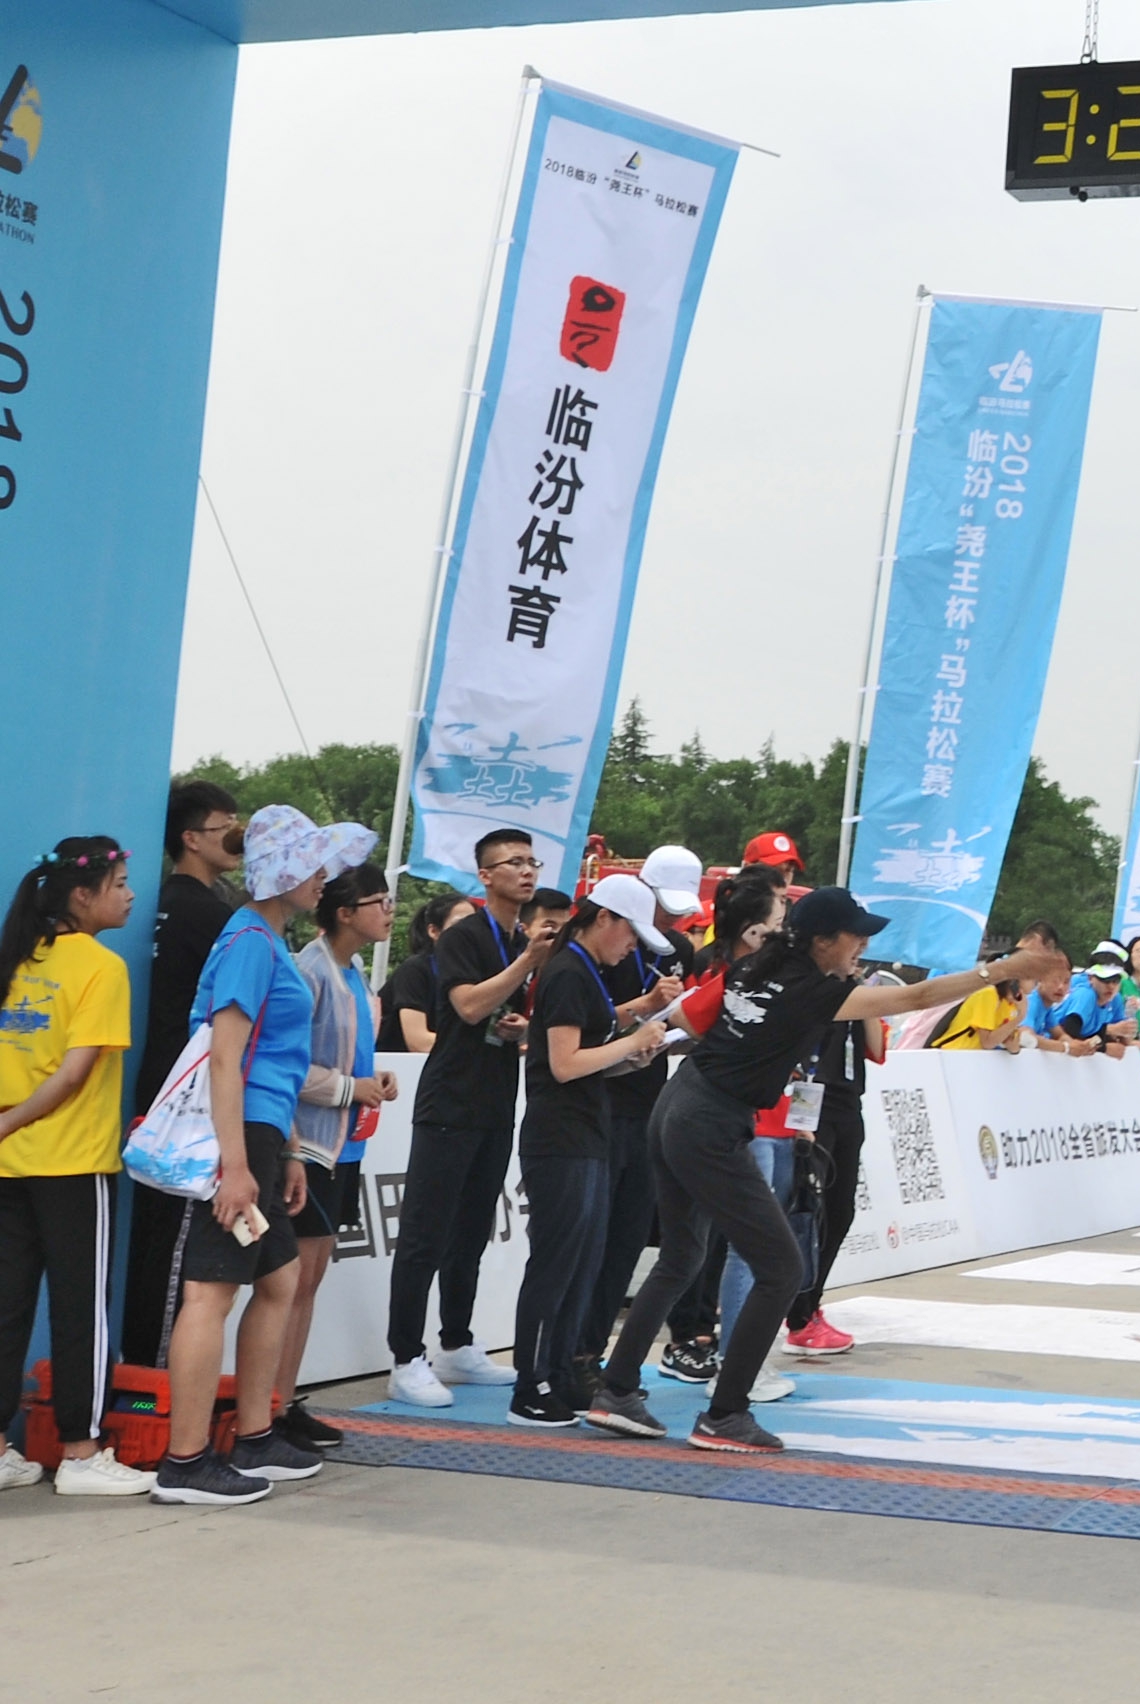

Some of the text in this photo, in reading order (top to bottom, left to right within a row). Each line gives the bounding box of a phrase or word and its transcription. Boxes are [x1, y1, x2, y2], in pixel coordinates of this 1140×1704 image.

[506, 384, 599, 649] 临汾体育
[995, 432, 1032, 519] 2018
